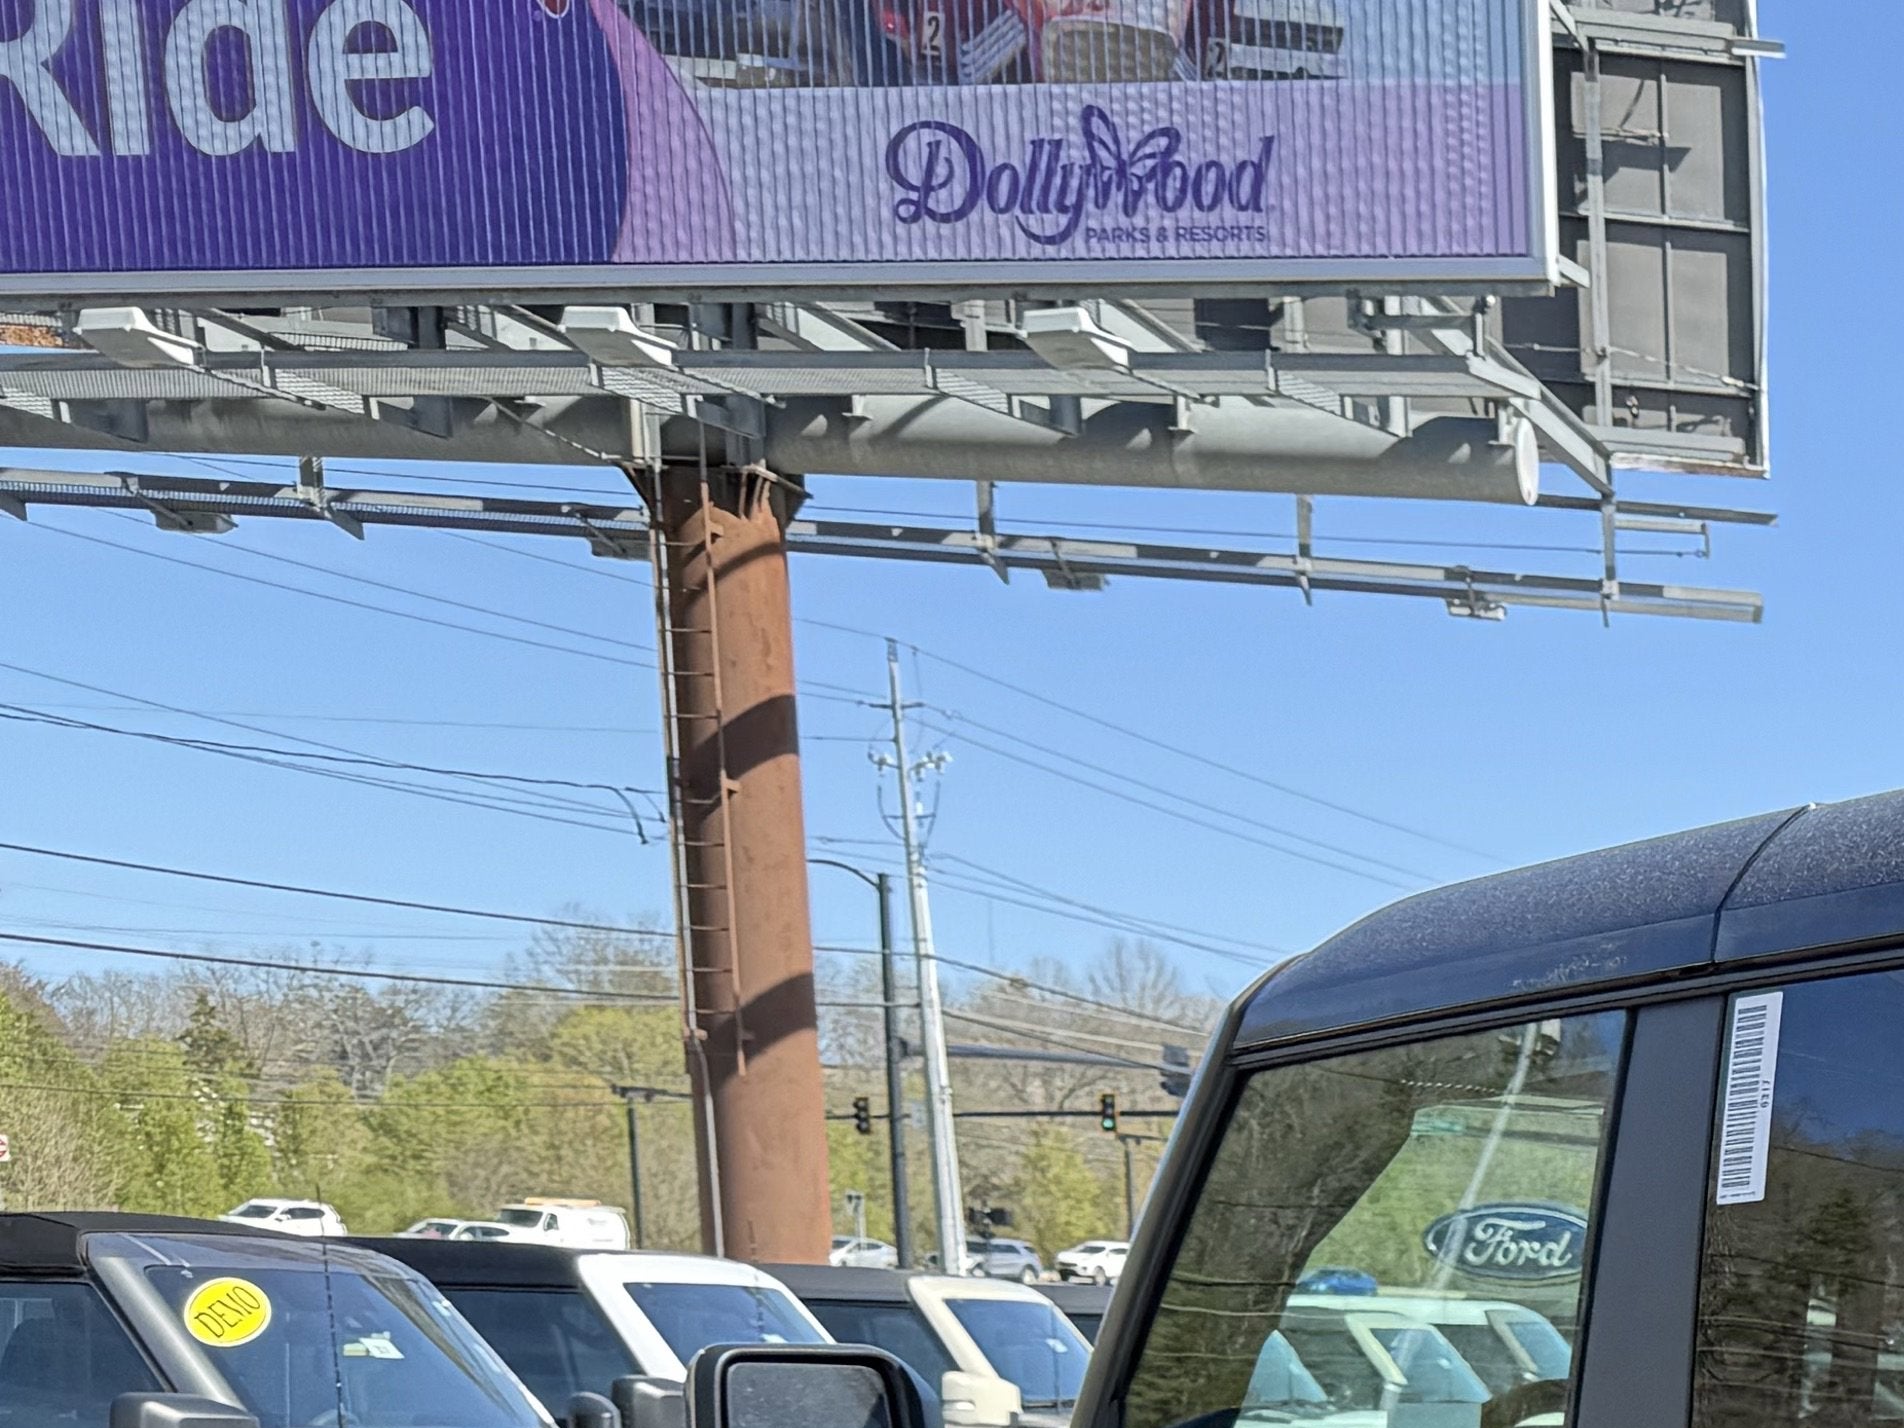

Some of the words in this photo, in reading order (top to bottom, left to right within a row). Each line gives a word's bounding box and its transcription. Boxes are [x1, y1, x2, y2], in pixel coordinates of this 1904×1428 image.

[1085, 226, 1151, 244] PARKS
[1155, 227, 1170, 244] &
[1174, 225, 1266, 243] RESORTS
[1463, 1217, 1572, 1267] Ford
[194, 1285, 261, 1338] DEMO
